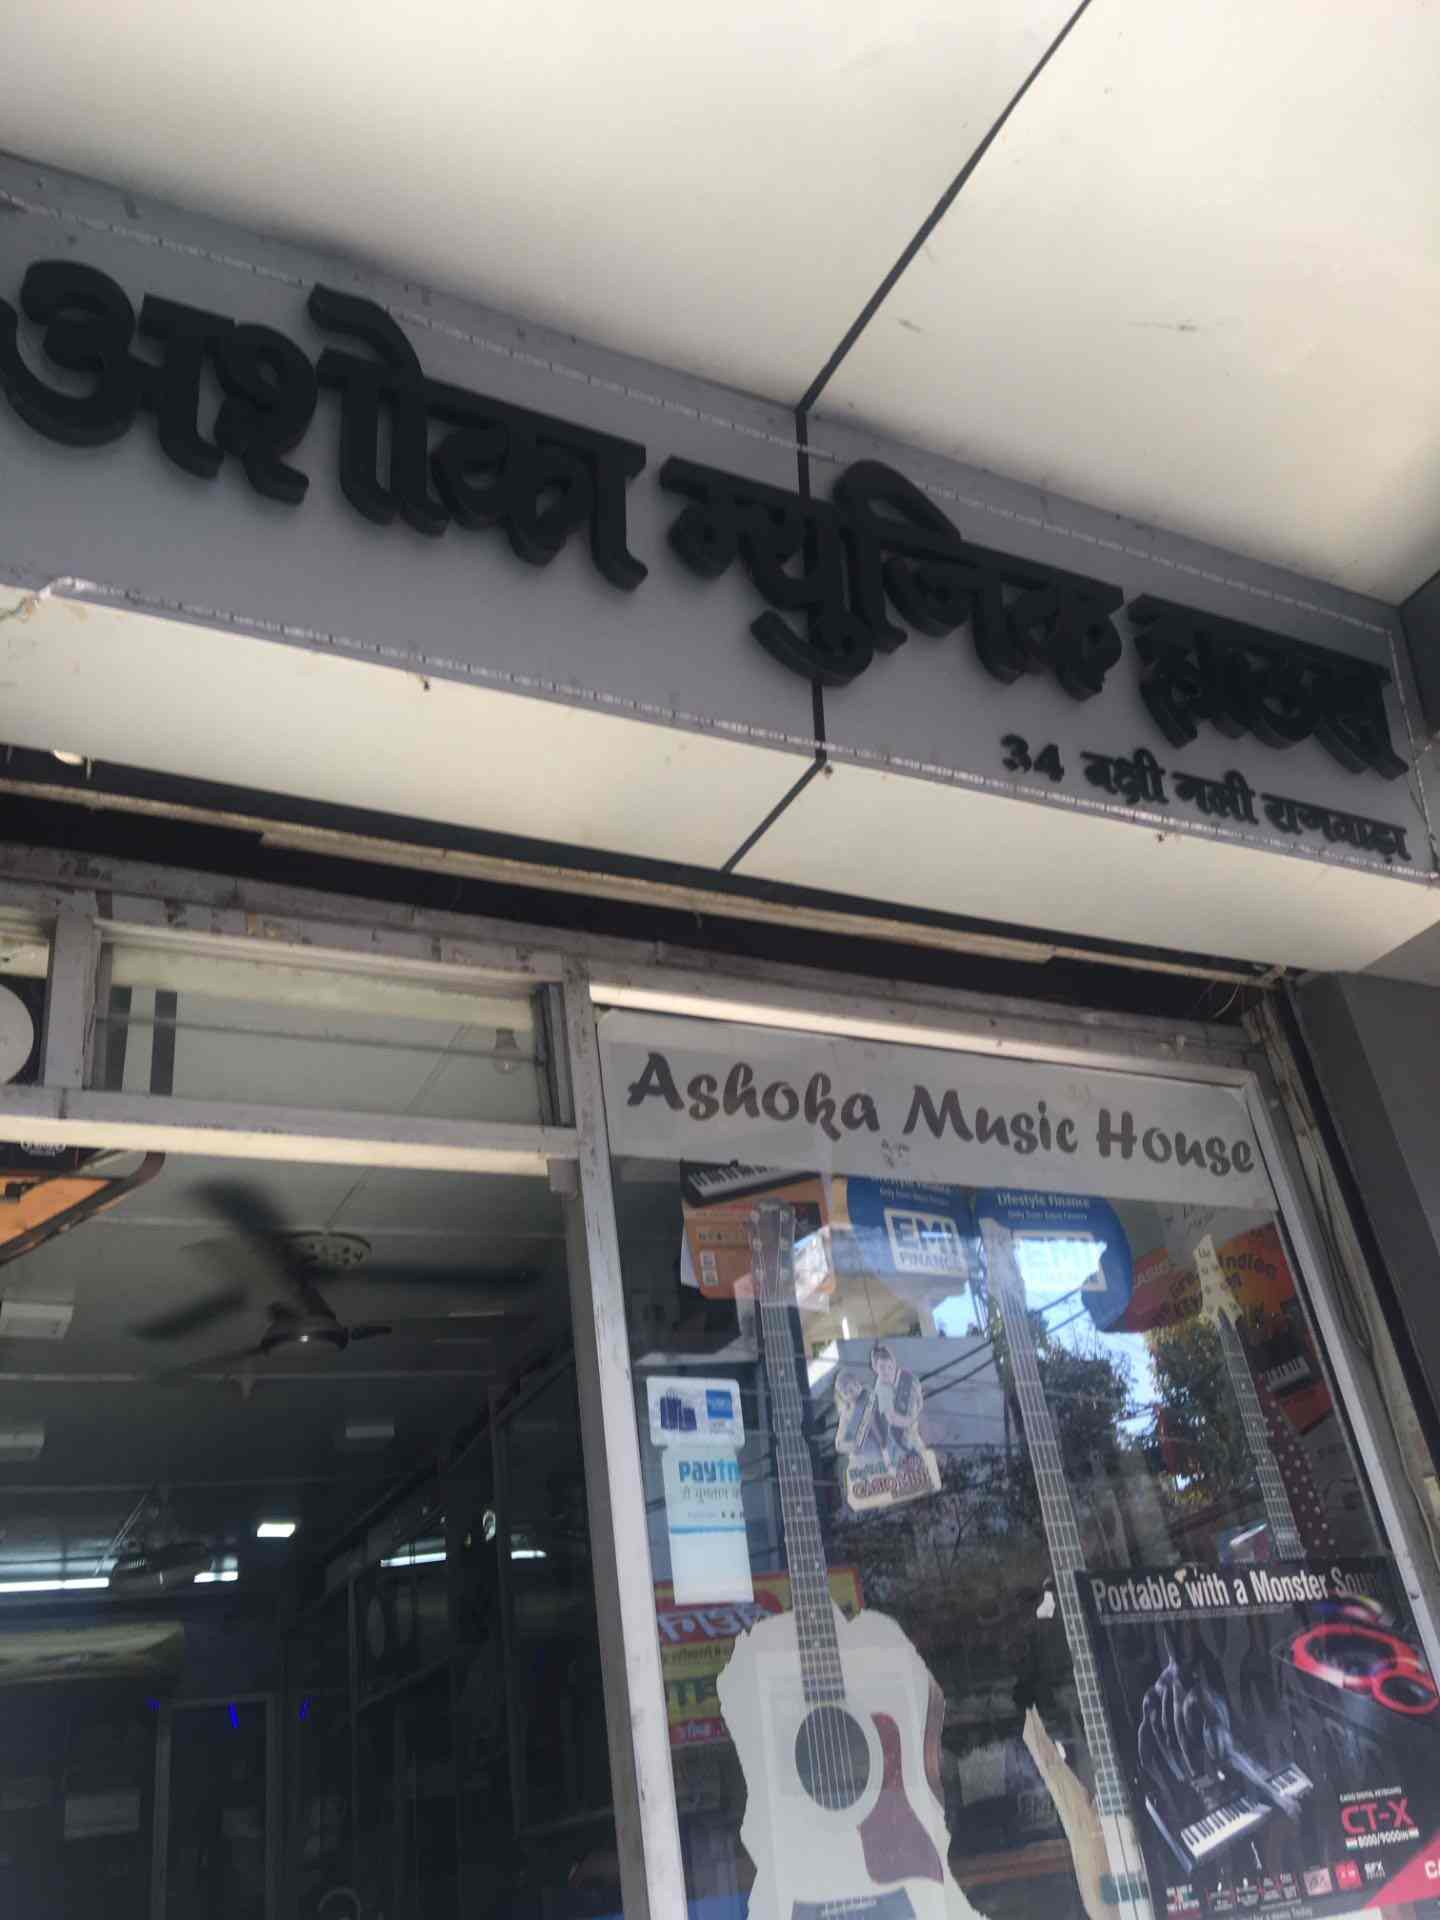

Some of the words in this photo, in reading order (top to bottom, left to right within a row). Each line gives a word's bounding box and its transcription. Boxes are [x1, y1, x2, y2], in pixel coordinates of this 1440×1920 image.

[0, 258, 648, 592] अशोका
[1001, 734, 1065, 782] 34
[626, 1051, 880, 1142] Ashoka
[902, 1084, 1078, 1154] Music
[1096, 1108, 1254, 1176] House
[891, 1215, 960, 1256] EMI
[1091, 1577, 1182, 1612] Portable
[1184, 1570, 1231, 1607] with
[1233, 1577, 1249, 1606] a
[1249, 1568, 1329, 1603] Monster
[1342, 1796, 1415, 1835] CT-X
